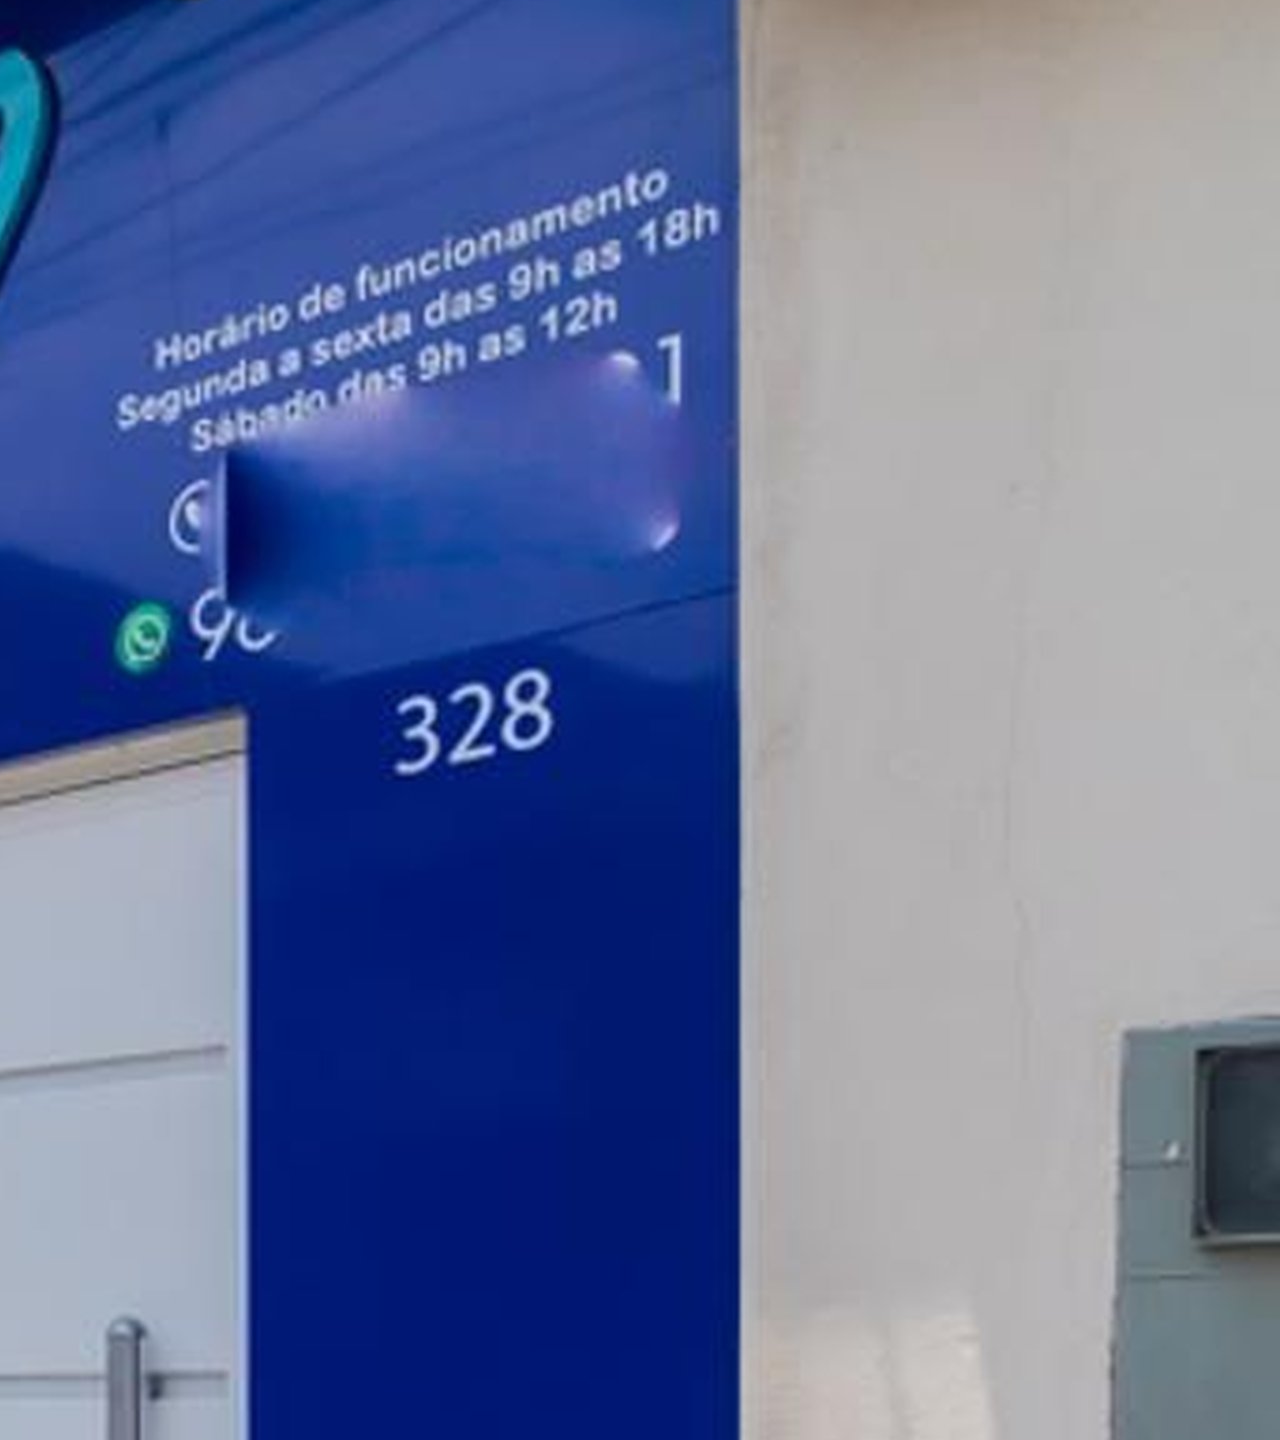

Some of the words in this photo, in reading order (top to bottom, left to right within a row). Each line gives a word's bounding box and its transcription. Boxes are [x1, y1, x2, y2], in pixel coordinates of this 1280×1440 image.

[115, 350, 271, 431] Segunda
[278, 346, 303, 377] a
[311, 307, 413, 370] sexta
[424, 279, 498, 330] das
[506, 256, 561, 302] 9h
[636, 201, 722, 256] 18h
[153, 301, 289, 370] Horário
[298, 282, 346, 322] de
[355, 167, 669, 303] funcionamento
[339, 362, 407, 406] das
[417, 338, 468, 383] 9h
[537, 289, 618, 342] 12h
[393, 667, 554, 776] 328
